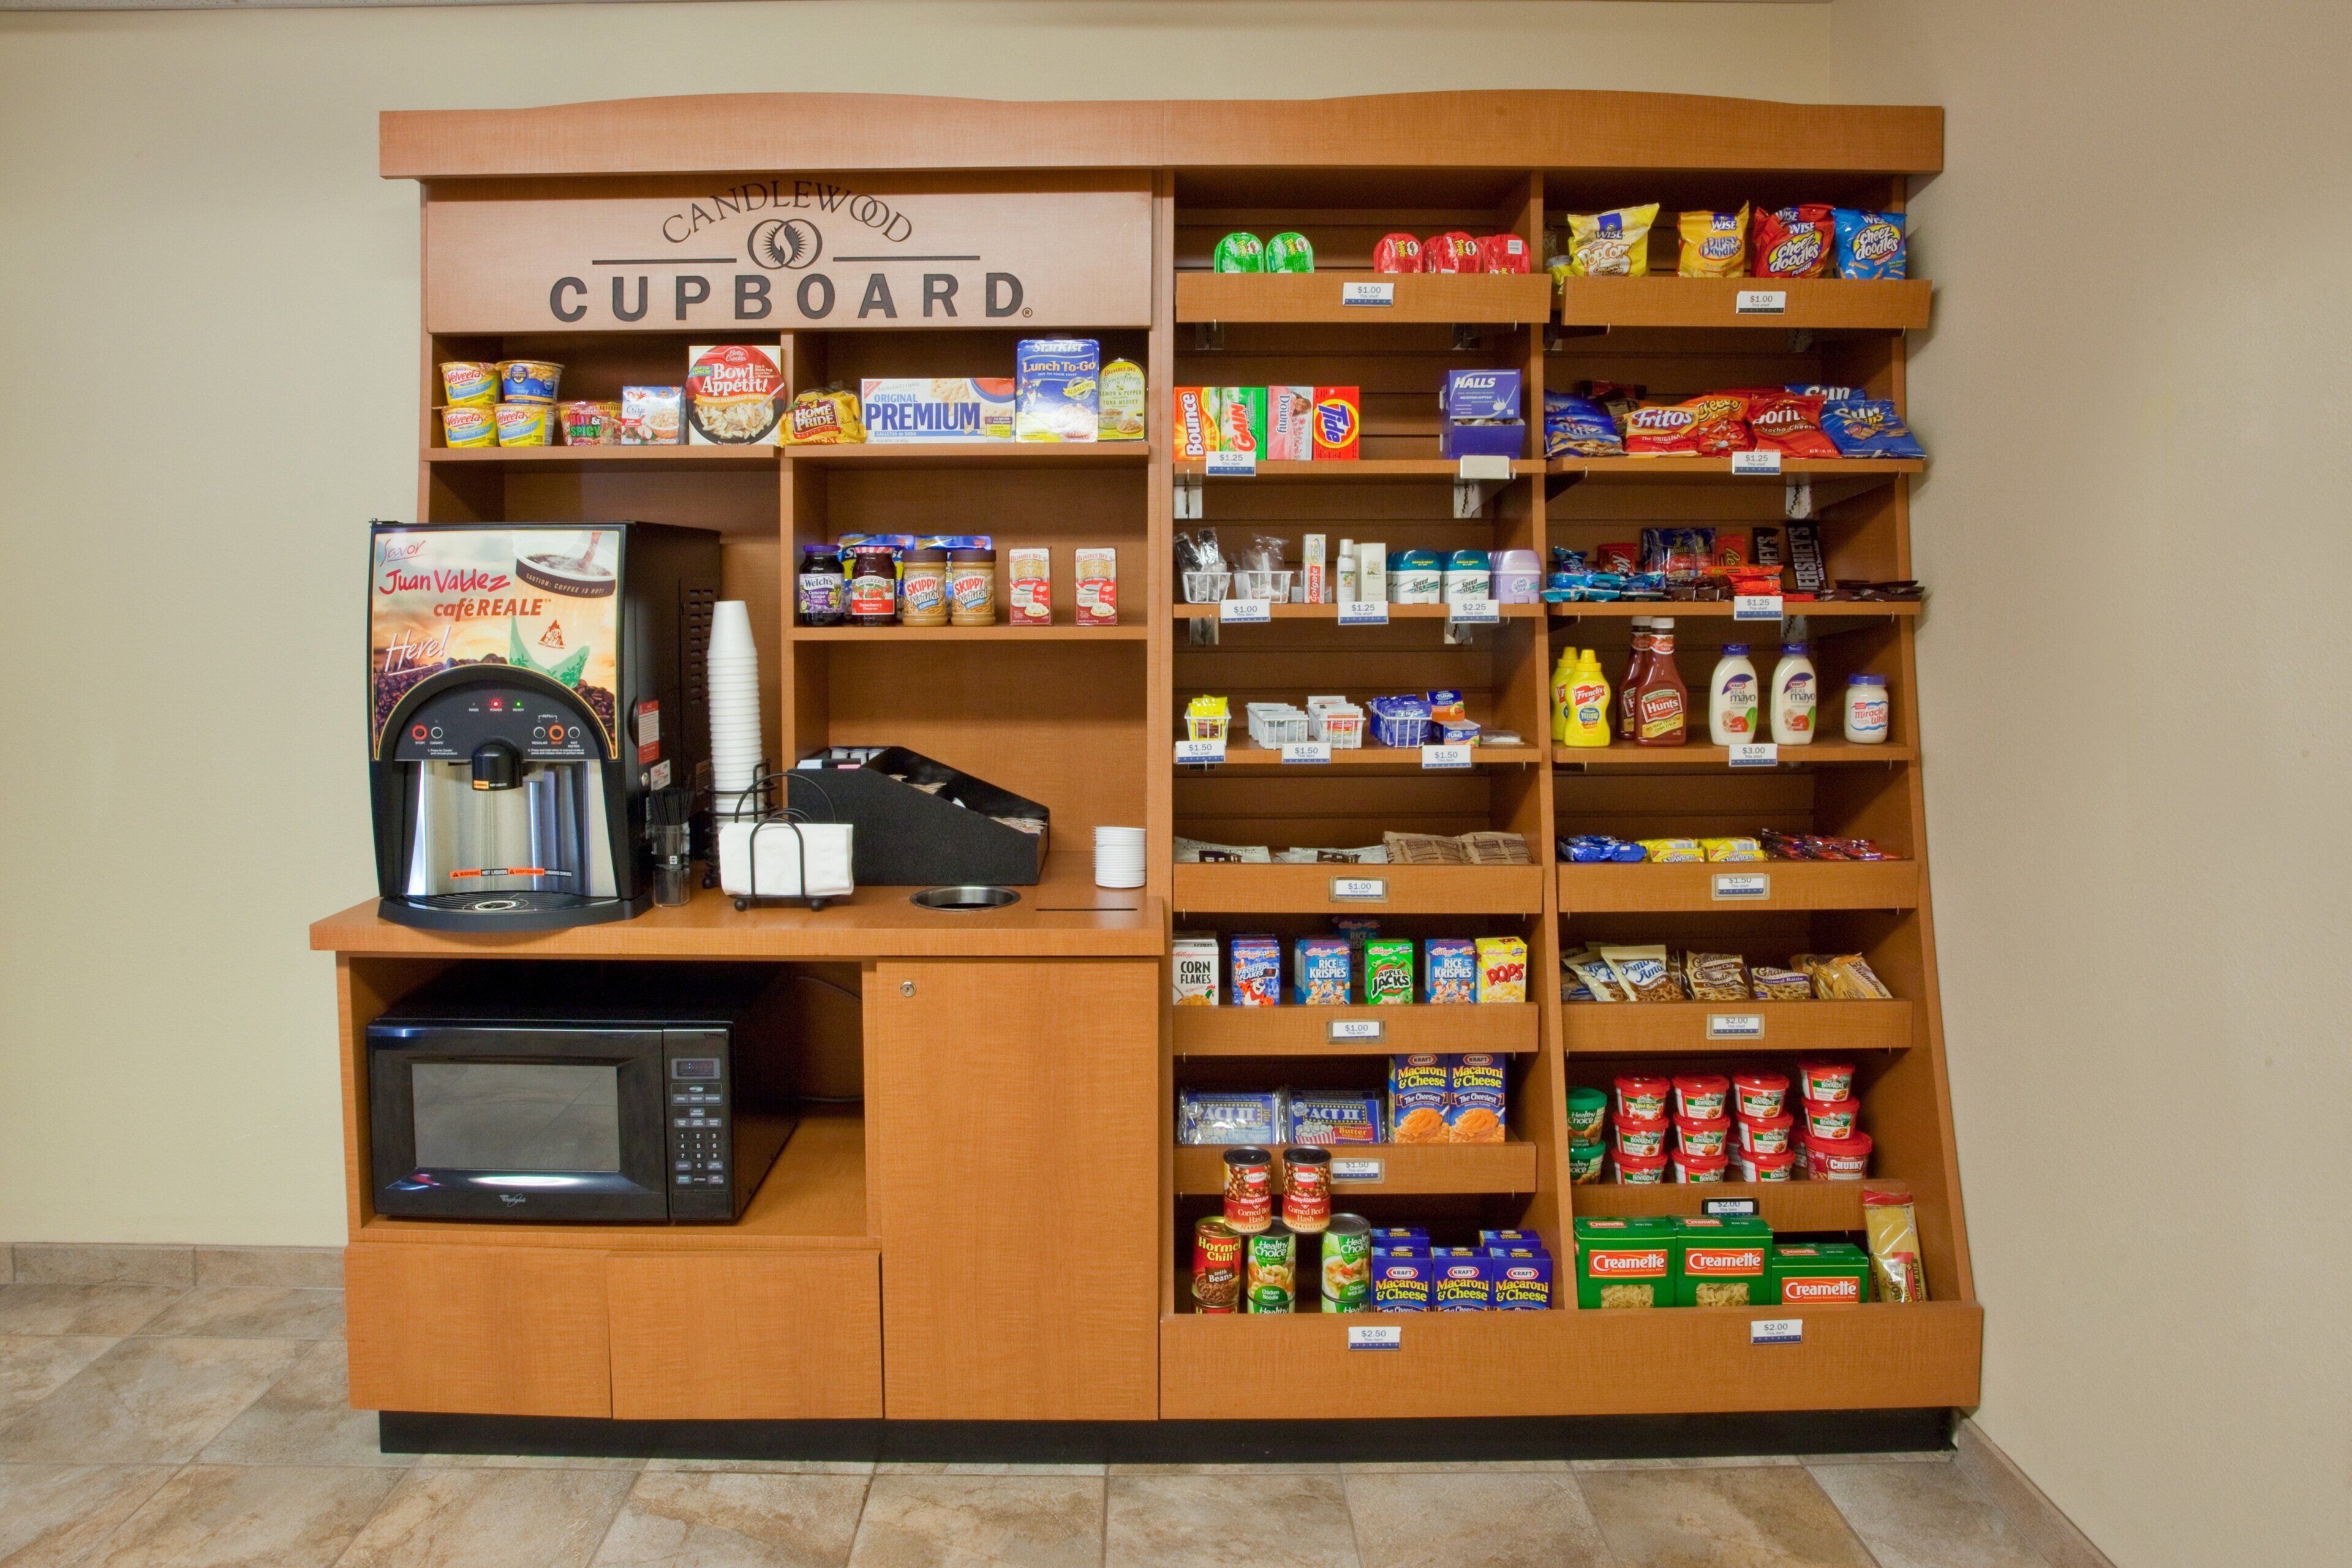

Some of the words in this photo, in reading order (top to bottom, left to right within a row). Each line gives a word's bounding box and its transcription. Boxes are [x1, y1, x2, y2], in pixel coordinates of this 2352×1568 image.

[662, 181, 913, 244] CANDLEWOOD
[1711, 221, 1737, 232] WISE
[1789, 222, 1814, 234] WISE
[1595, 230, 1623, 239] WISE
[1860, 227, 1893, 244] cheez
[1706, 236, 1738, 249] Dipsy
[1777, 234, 1814, 257] cheez
[1700, 245, 1740, 257] Doodles
[1855, 238, 1898, 261] doodles
[1770, 244, 1819, 272] doodles
[1791, 262, 1812, 276] PUFFED
[549, 273, 1024, 322] CUPBOARD
[1033, 342, 1083, 352] StarKist
[712, 364, 753, 380] Bowl
[1023, 361, 1060, 372] Lunch
[1061, 361, 1096, 371] To-Go
[447, 371, 481, 383] Velveeta
[1454, 377, 1496, 388] HALLS
[700, 376, 768, 396] Appétit!
[1066, 382, 1093, 394] ALBACORE
[874, 394, 918, 402] ORIGINAL
[627, 405, 645, 417] Crisp
[796, 405, 832, 417] HOME
[865, 402, 981, 431] PREMIUM
[1277, 394, 1291, 433] Downy
[1834, 407, 1882, 418] Sun
[447, 413, 481, 426] Velveeta
[570, 414, 591, 426] HOT
[796, 415, 835, 431] PRIDE
[1183, 393, 1205, 456] Bounce
[1317, 403, 1349, 443] Tide
[1632, 409, 1694, 428] Fritos
[570, 426, 600, 437] SPICY
[1231, 402, 1253, 451] GAIN
[380, 538, 426, 567] Savor
[379, 569, 431, 594] Juan
[434, 568, 511, 593] Valdez
[526, 573, 551, 587] CAUTION:
[554, 584, 579, 593] COFFEE
[805, 576, 833, 587] Welch's
[954, 578, 984, 596] SKIPPY
[907, 579, 937, 596] SKIPPY
[910, 589, 940, 605] Natural
[958, 587, 988, 605] Natural
[385, 627, 451, 673] Here!
[1577, 687, 1604, 699] French's
[1730, 693, 1756, 703] mayo
[1790, 692, 1815, 702] mayo
[1855, 707, 1883, 719] miracle
[1871, 714, 1887, 724] Whip
[1181, 961, 1210, 973] CORN
[1238, 963, 1268, 974] FROSTED
[1319, 959, 1337, 968] RICE
[1444, 959, 1462, 968] RICE
[1180, 974, 1211, 984] FLAKES
[1238, 970, 1264, 980] FLAKES
[1310, 968, 1346, 978] KRISPIES
[1434, 968, 1472, 978] KRISPIES
[1486, 963, 1525, 986] POPS
[1371, 974, 1410, 997] JACKS
[1398, 1066, 1447, 1079] Macaroni
[1452, 1066, 1503, 1079] Macaroni
[1398, 1079, 1407, 1088] &
[1408, 1076, 1446, 1087] Cheese
[1453, 1079, 1461, 1088] &
[1463, 1076, 1502, 1087] Cheese
[1416, 1092, 1440, 1102] Cheesiest
[1309, 1107, 1338, 1120] ACT
[1341, 1108, 1360, 1120] II
[1339, 1127, 1367, 1136] Butter
[1830, 1159, 1863, 1170] CHUNKY
[1288, 1205, 1310, 1215] Corned
[1198, 1237, 1241, 1252] Hormel
[1259, 1240, 1289, 1249] Healthy
[1207, 1251, 1233, 1262] Chili
[1256, 1245, 1287, 1257] Choice
[1593, 1253, 1664, 1272] Creamette
[1689, 1252, 1760, 1270] Creamette
[1209, 1272, 1232, 1283] Beans
[1376, 1279, 1428, 1292] Macaroni
[1436, 1279, 1489, 1292] Macaroni
[1496, 1280, 1548, 1294] Macaroni
[1785, 1280, 1856, 1299] Creamette
[1376, 1292, 1385, 1300] &
[1386, 1289, 1427, 1301] Cheese
[1437, 1292, 1446, 1300] &
[1447, 1289, 1488, 1300] Cheese
[1496, 1292, 1505, 1302] &
[1506, 1289, 1547, 1302] Cheese
